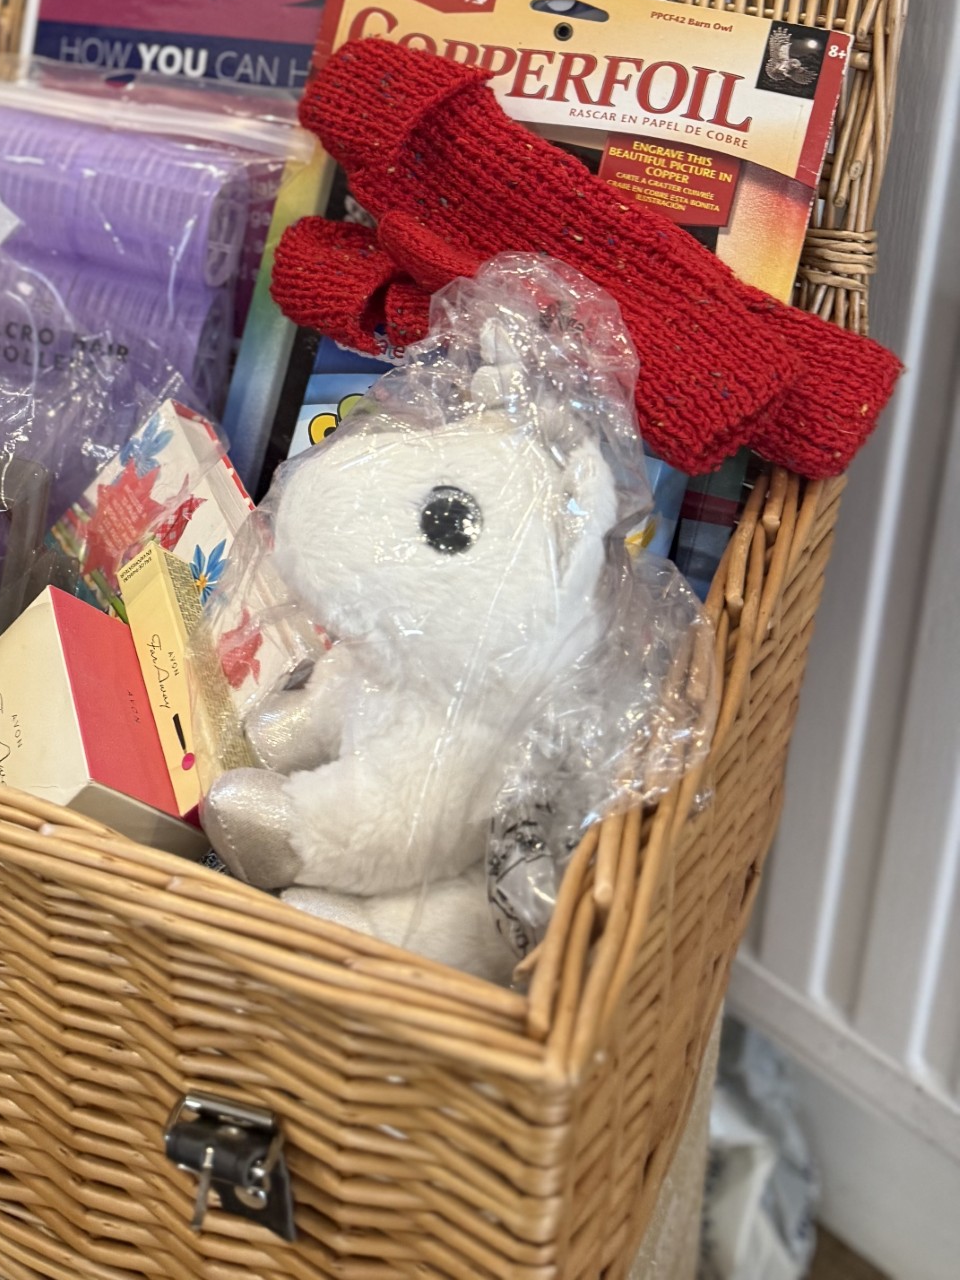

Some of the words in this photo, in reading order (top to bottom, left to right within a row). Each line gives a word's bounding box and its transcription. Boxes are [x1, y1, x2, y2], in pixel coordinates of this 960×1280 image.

[650, 11, 685, 24] PPCF42
[688, 17, 711, 28] Barn
[713, 22, 733, 32] Owl
[59, 36, 132, 69] HOW
[138, 42, 208, 77] YOU
[215, 51, 279, 86] CAN
[828, 45, 846, 59] 8+
[569, 108, 617, 122] RASCAR
[621, 114, 637, 124] EN
[642, 117, 679, 132] PAPEL
[685, 124, 703, 136] DE
[706, 130, 749, 149] COBRE
[609, 146, 667, 168] BEAUTIFUL
[670, 160, 717, 180] PICTURE
[718, 171, 733, 183] IN
[633, 141, 685, 159] ENGRAVE
[687, 152, 713, 167] THIS
[645, 166, 690, 184] COPPER
[647, 178, 682, 193] GRATTER
[670, 194, 689, 205] ESTA
[168, 651, 179, 676] AVON
[11, 714, 22, 748] AVON
